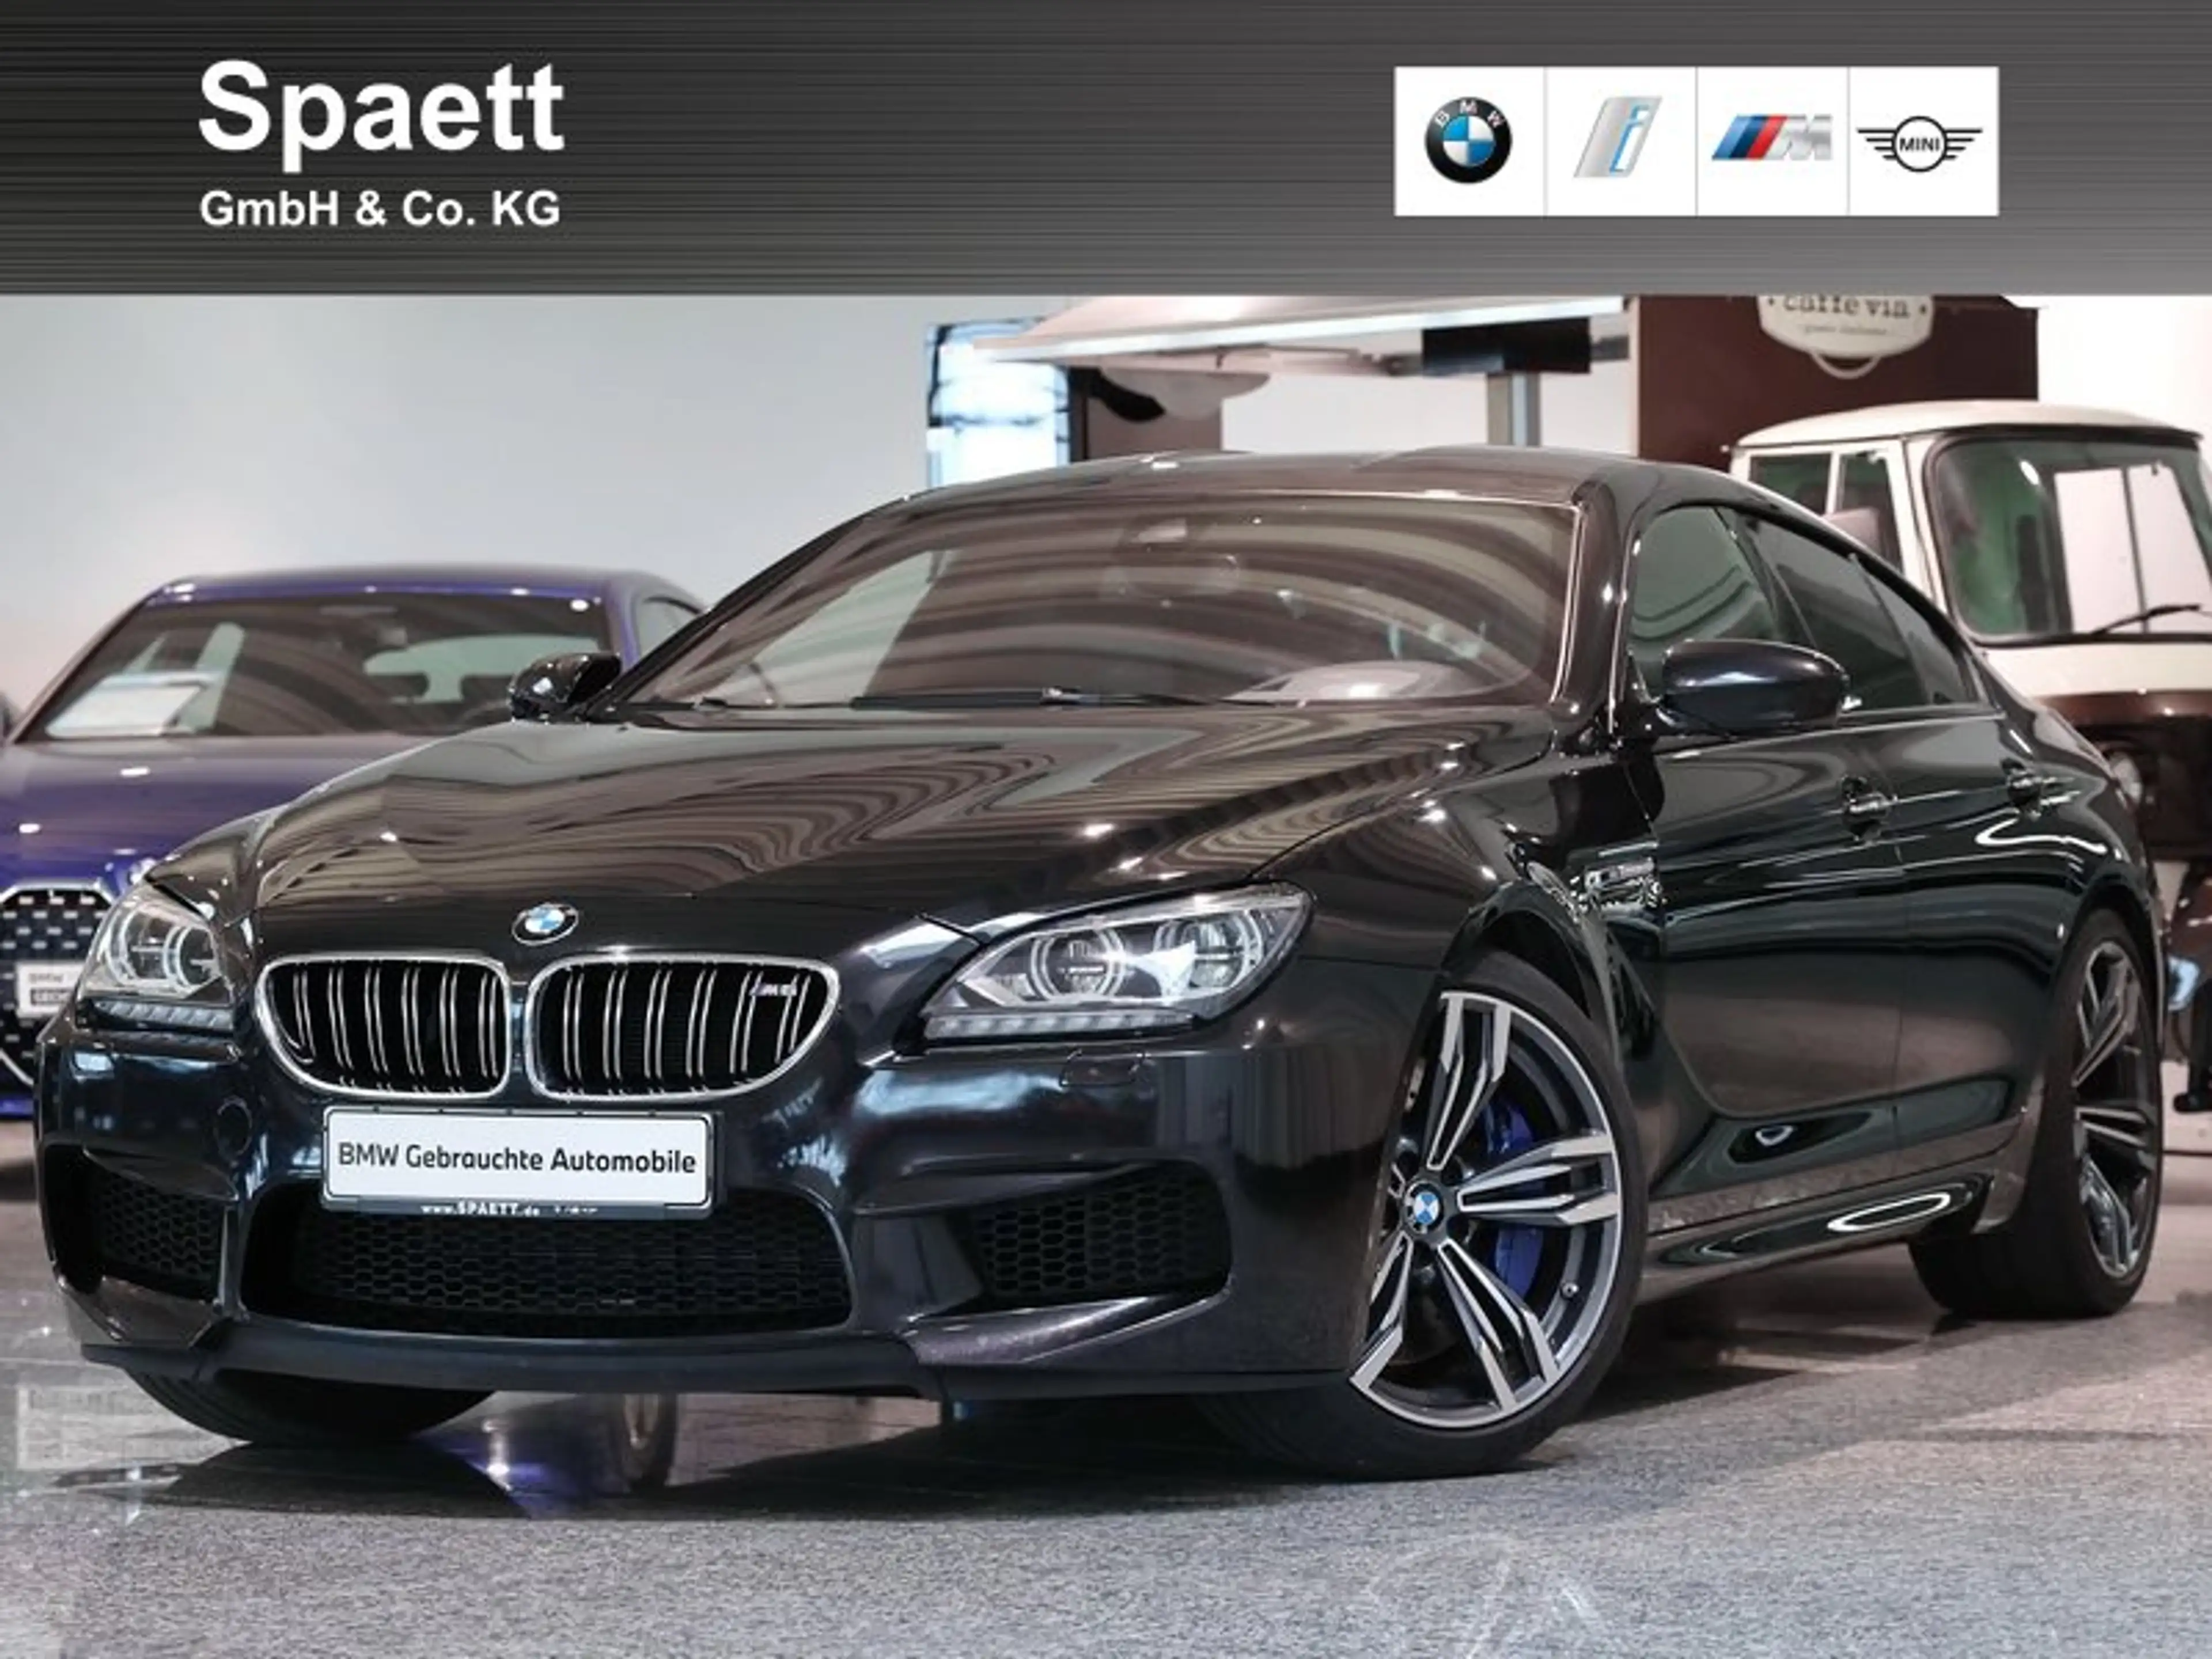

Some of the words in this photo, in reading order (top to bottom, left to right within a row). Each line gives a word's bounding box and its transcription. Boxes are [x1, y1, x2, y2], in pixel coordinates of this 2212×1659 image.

[339, 1142, 399, 1167] BMW
[406, 1144, 543, 1171] Gebrauchte
[550, 1147, 696, 1173] Automobile
